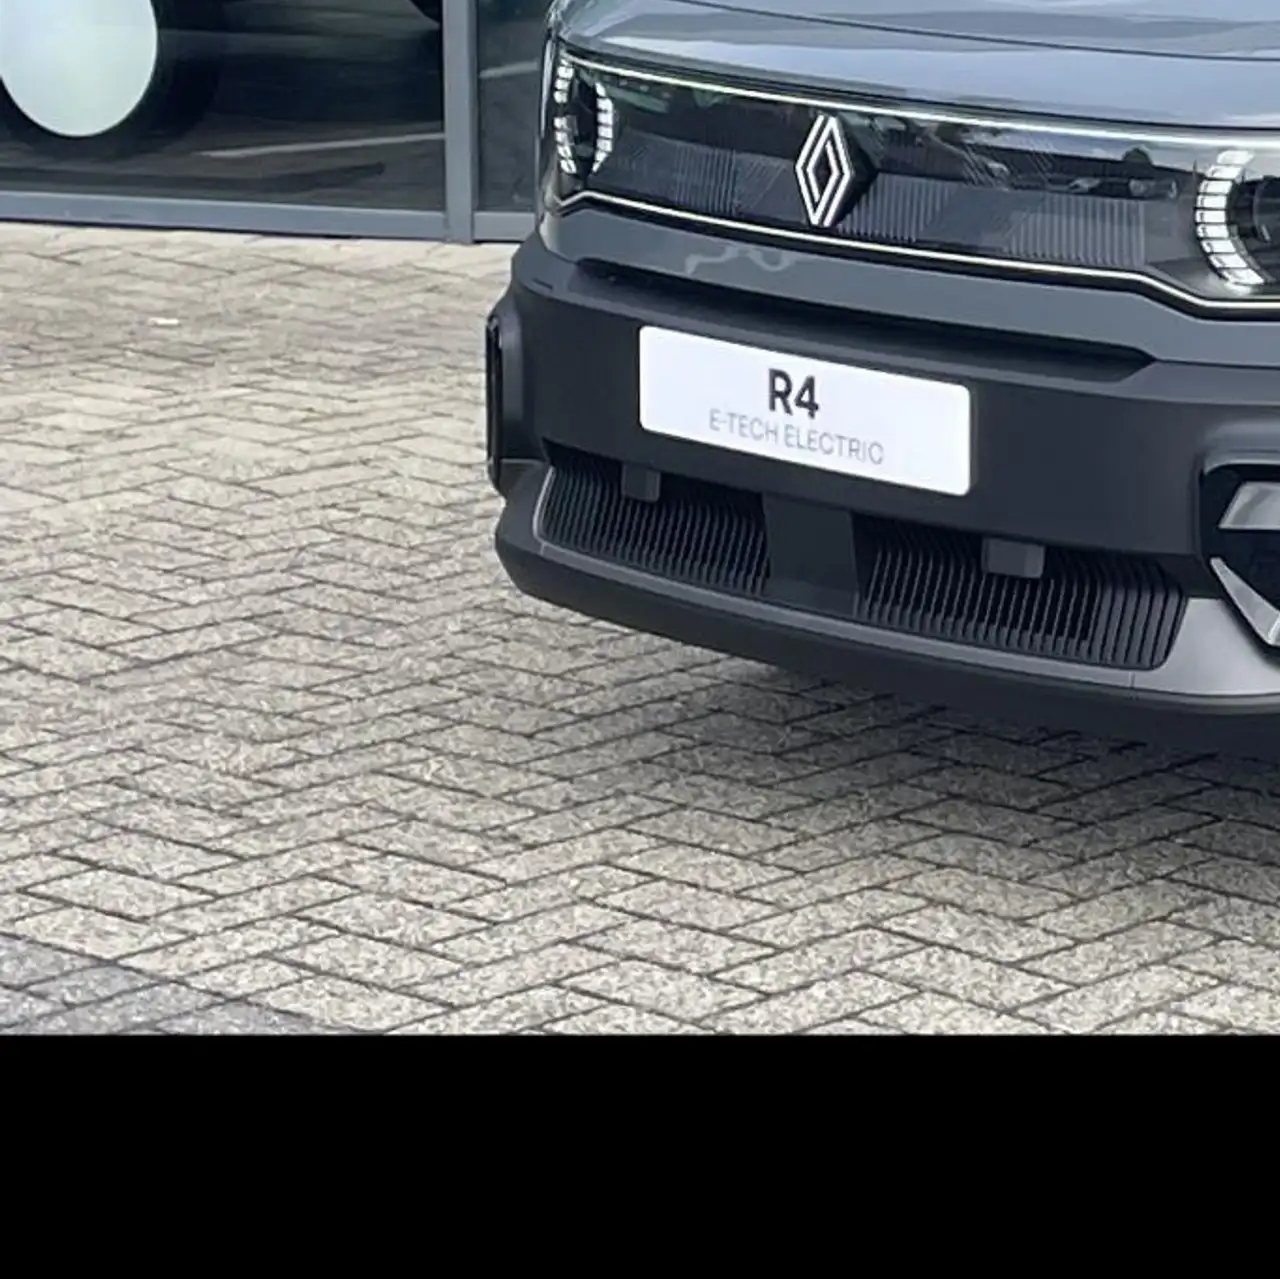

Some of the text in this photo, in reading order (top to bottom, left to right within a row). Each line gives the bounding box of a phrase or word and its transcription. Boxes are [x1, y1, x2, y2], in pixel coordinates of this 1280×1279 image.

[767, 368, 820, 419] R4
[708, 407, 885, 466] E-TECH ELECTRIC
